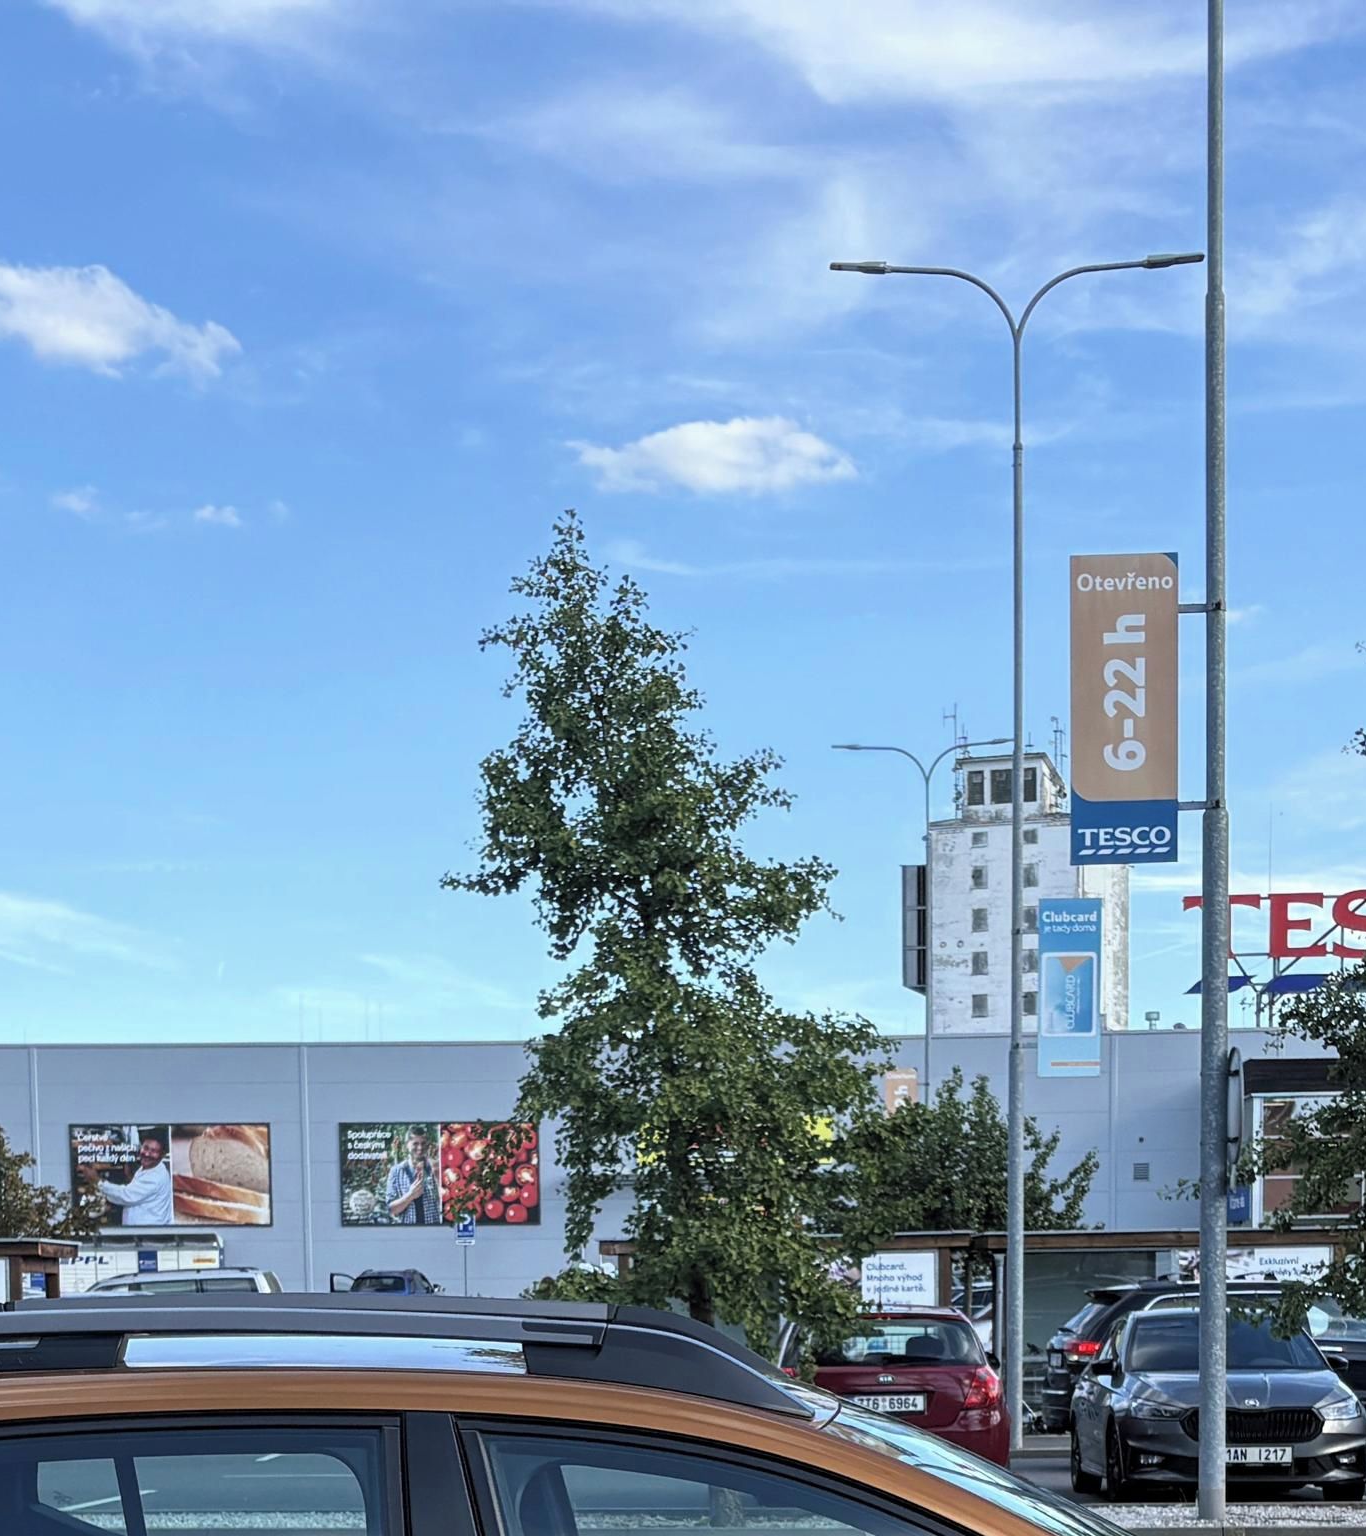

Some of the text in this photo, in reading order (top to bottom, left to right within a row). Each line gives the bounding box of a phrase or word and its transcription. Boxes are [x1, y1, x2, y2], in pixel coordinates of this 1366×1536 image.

[1076, 572, 1174, 592] Otevřeno
[1102, 614, 1147, 771] 6-22 h
[1077, 825, 1171, 847] TESCO
[1041, 911, 1097, 923] Clubcard
[1072, 923, 1096, 933] doma
[888, 1397, 918, 1409] 6964
[1226, 1448, 1248, 1461] 1AN
